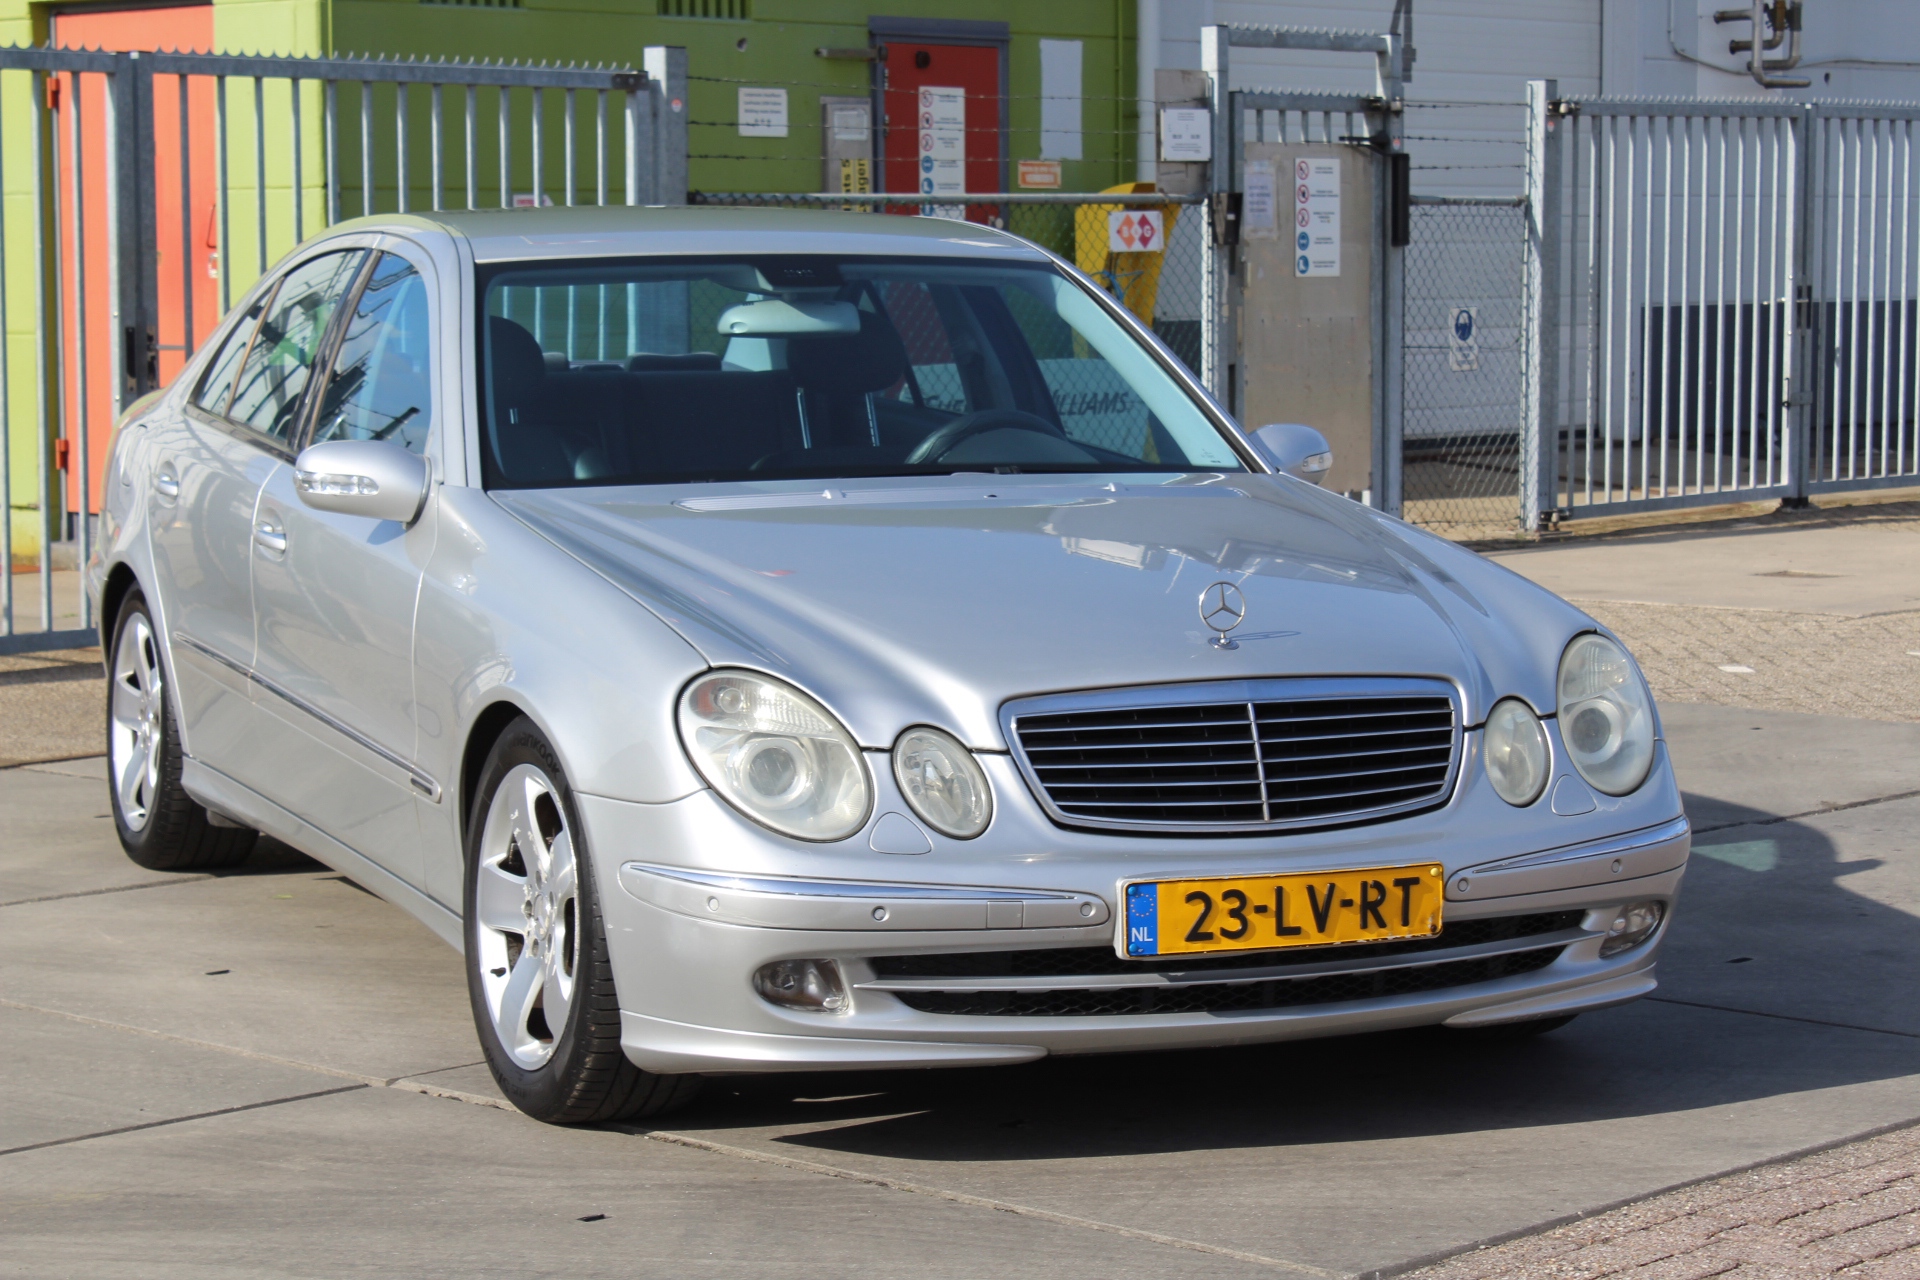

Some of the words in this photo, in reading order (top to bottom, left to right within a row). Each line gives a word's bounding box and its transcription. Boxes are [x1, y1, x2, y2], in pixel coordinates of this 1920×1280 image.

[1052, 389, 1129, 415] ILLIAMS
[1184, 876, 1420, 942] 23-LV-RT
[1131, 926, 1153, 942] NL
